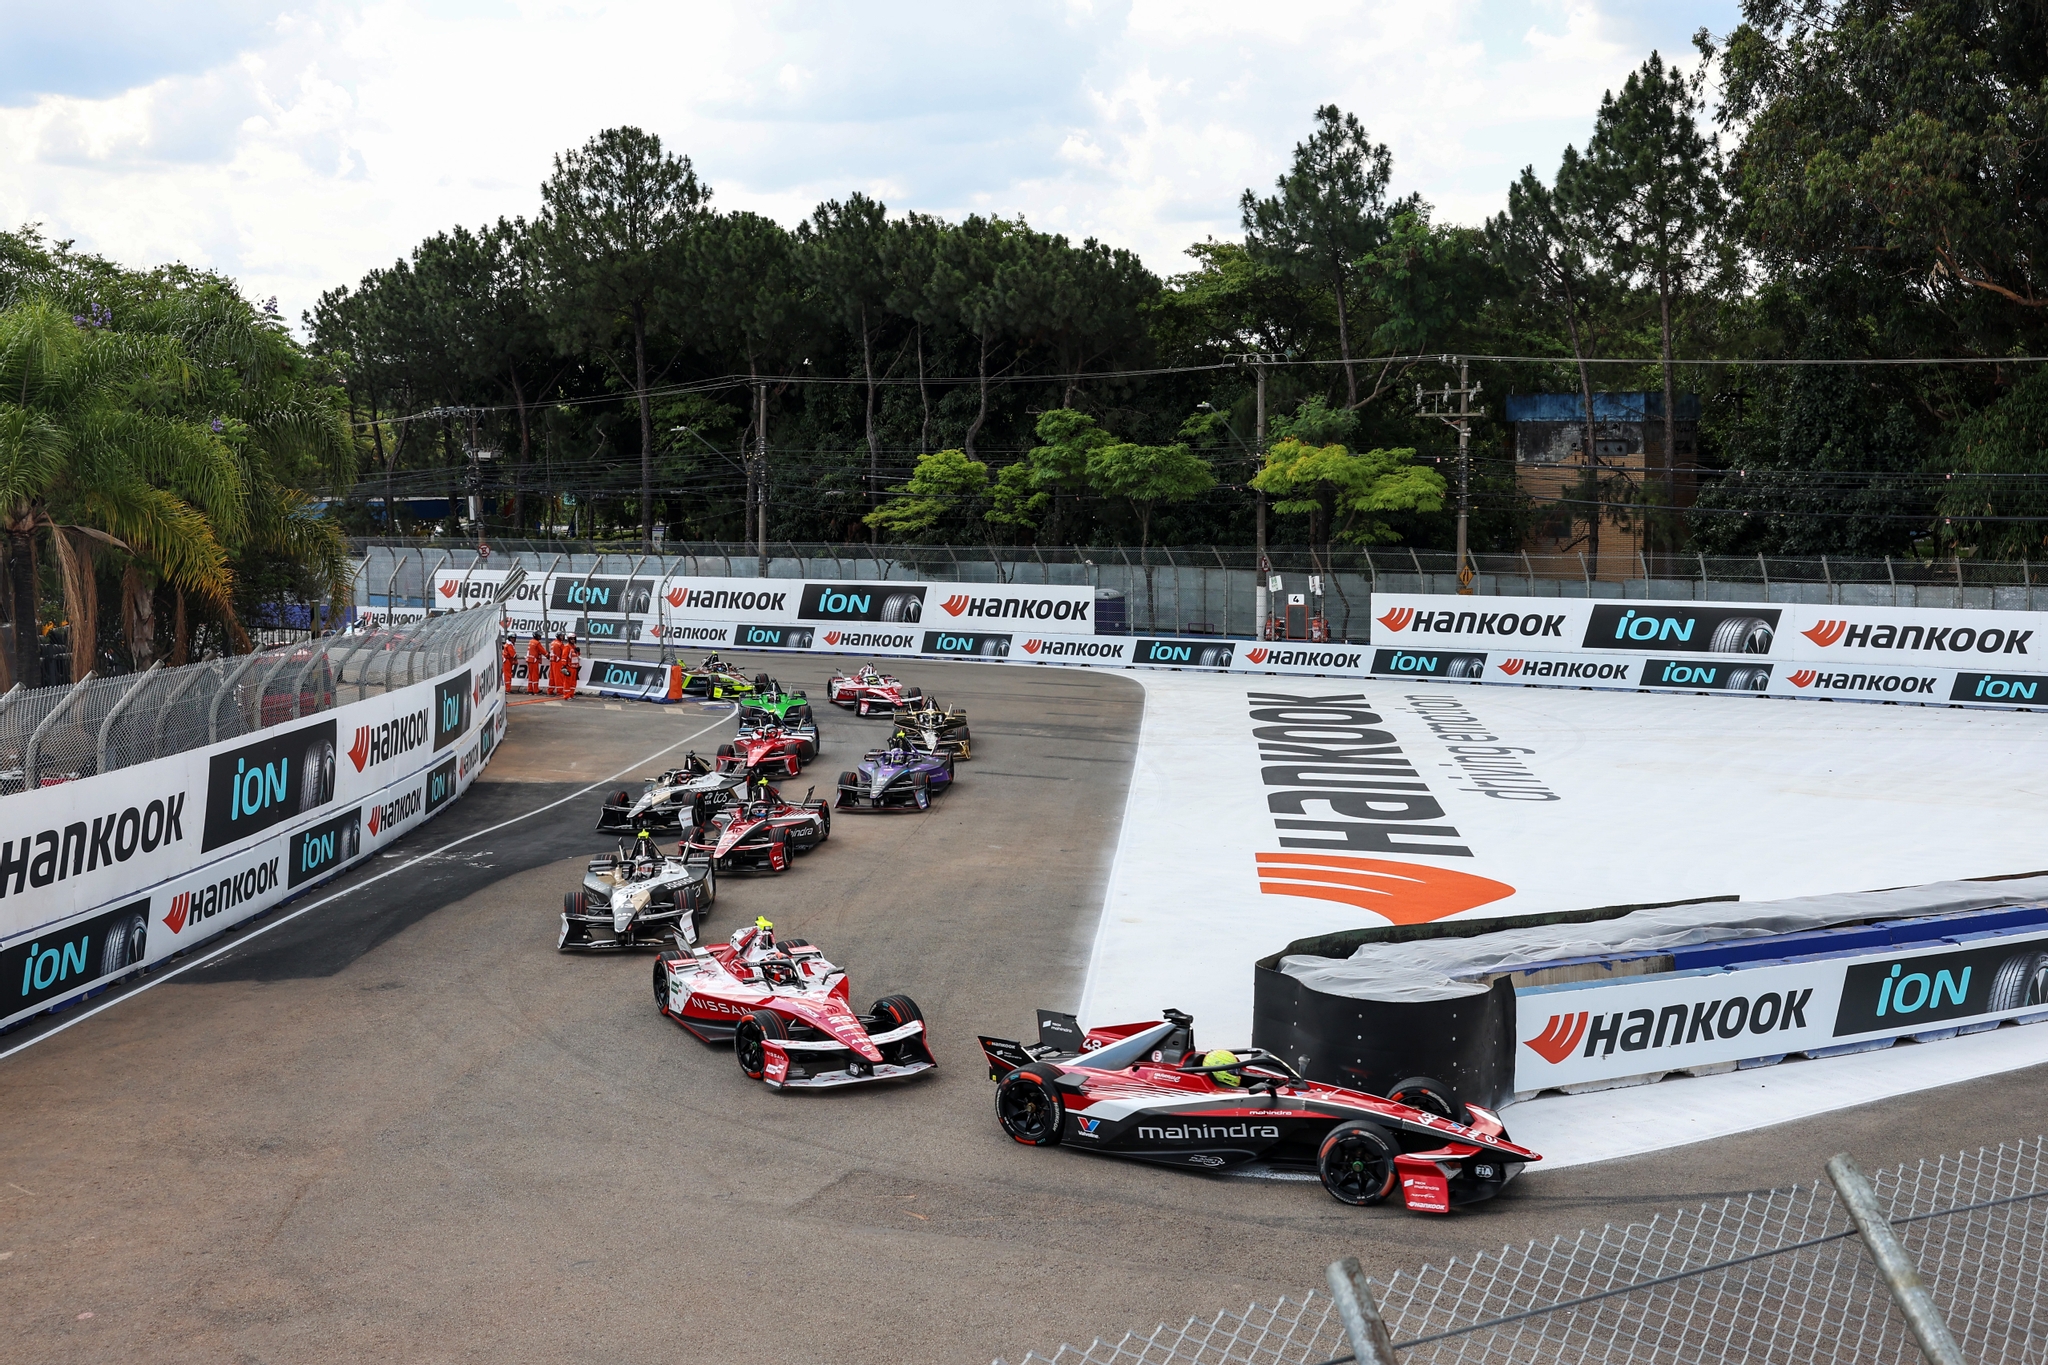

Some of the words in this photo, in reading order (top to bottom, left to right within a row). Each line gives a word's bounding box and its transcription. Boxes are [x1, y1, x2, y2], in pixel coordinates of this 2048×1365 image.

[818, 587, 871, 613] iON
[747, 625, 781, 644] iON
[1615, 609, 1695, 641] iON
[936, 633, 974, 651] iON
[1149, 641, 1191, 661] iON
[1390, 651, 1437, 672] iON
[1661, 661, 1716, 683] iON
[1975, 674, 2038, 699] iON
[1395, 695, 1500, 742] emotion
[1438, 745, 1562, 801] driving
[231, 757, 288, 821] iON
[302, 833, 335, 873] iON
[22, 935, 89, 997] iON
[1876, 964, 1972, 1017] iON
[691, 996, 752, 1016] NISSAN
[1082, 1038, 1102, 1051] 48
[1138, 1123, 1279, 1139] mahindra
